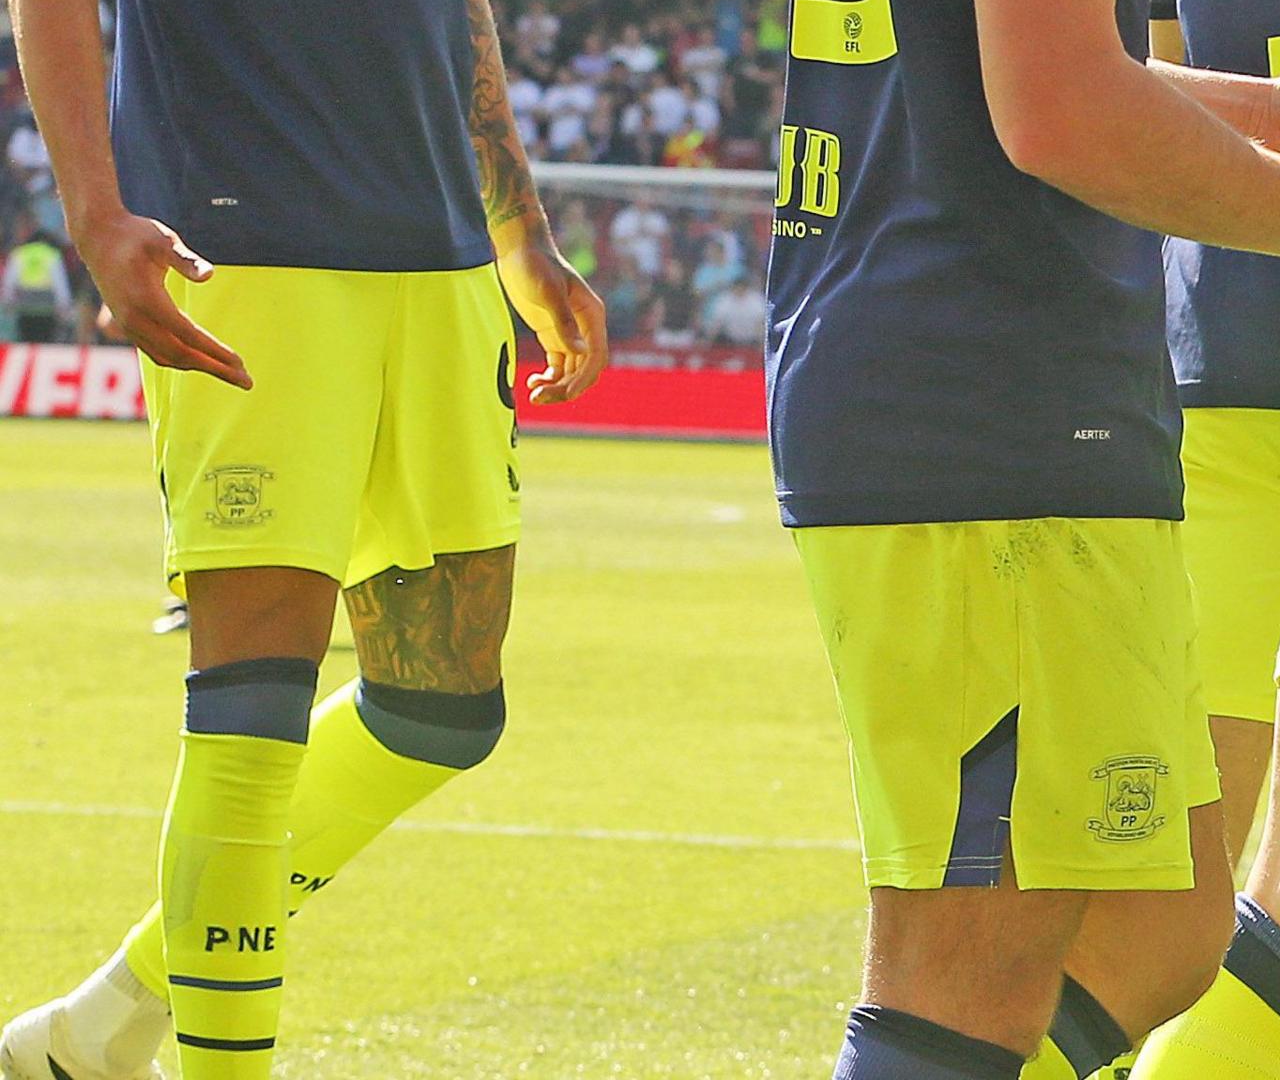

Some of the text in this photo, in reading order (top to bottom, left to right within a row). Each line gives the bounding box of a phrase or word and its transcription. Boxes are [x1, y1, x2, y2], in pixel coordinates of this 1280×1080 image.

[845, 41, 861, 53] EFL
[1121, 815, 1137, 827] PP
[205, 926, 276, 952] PNE
